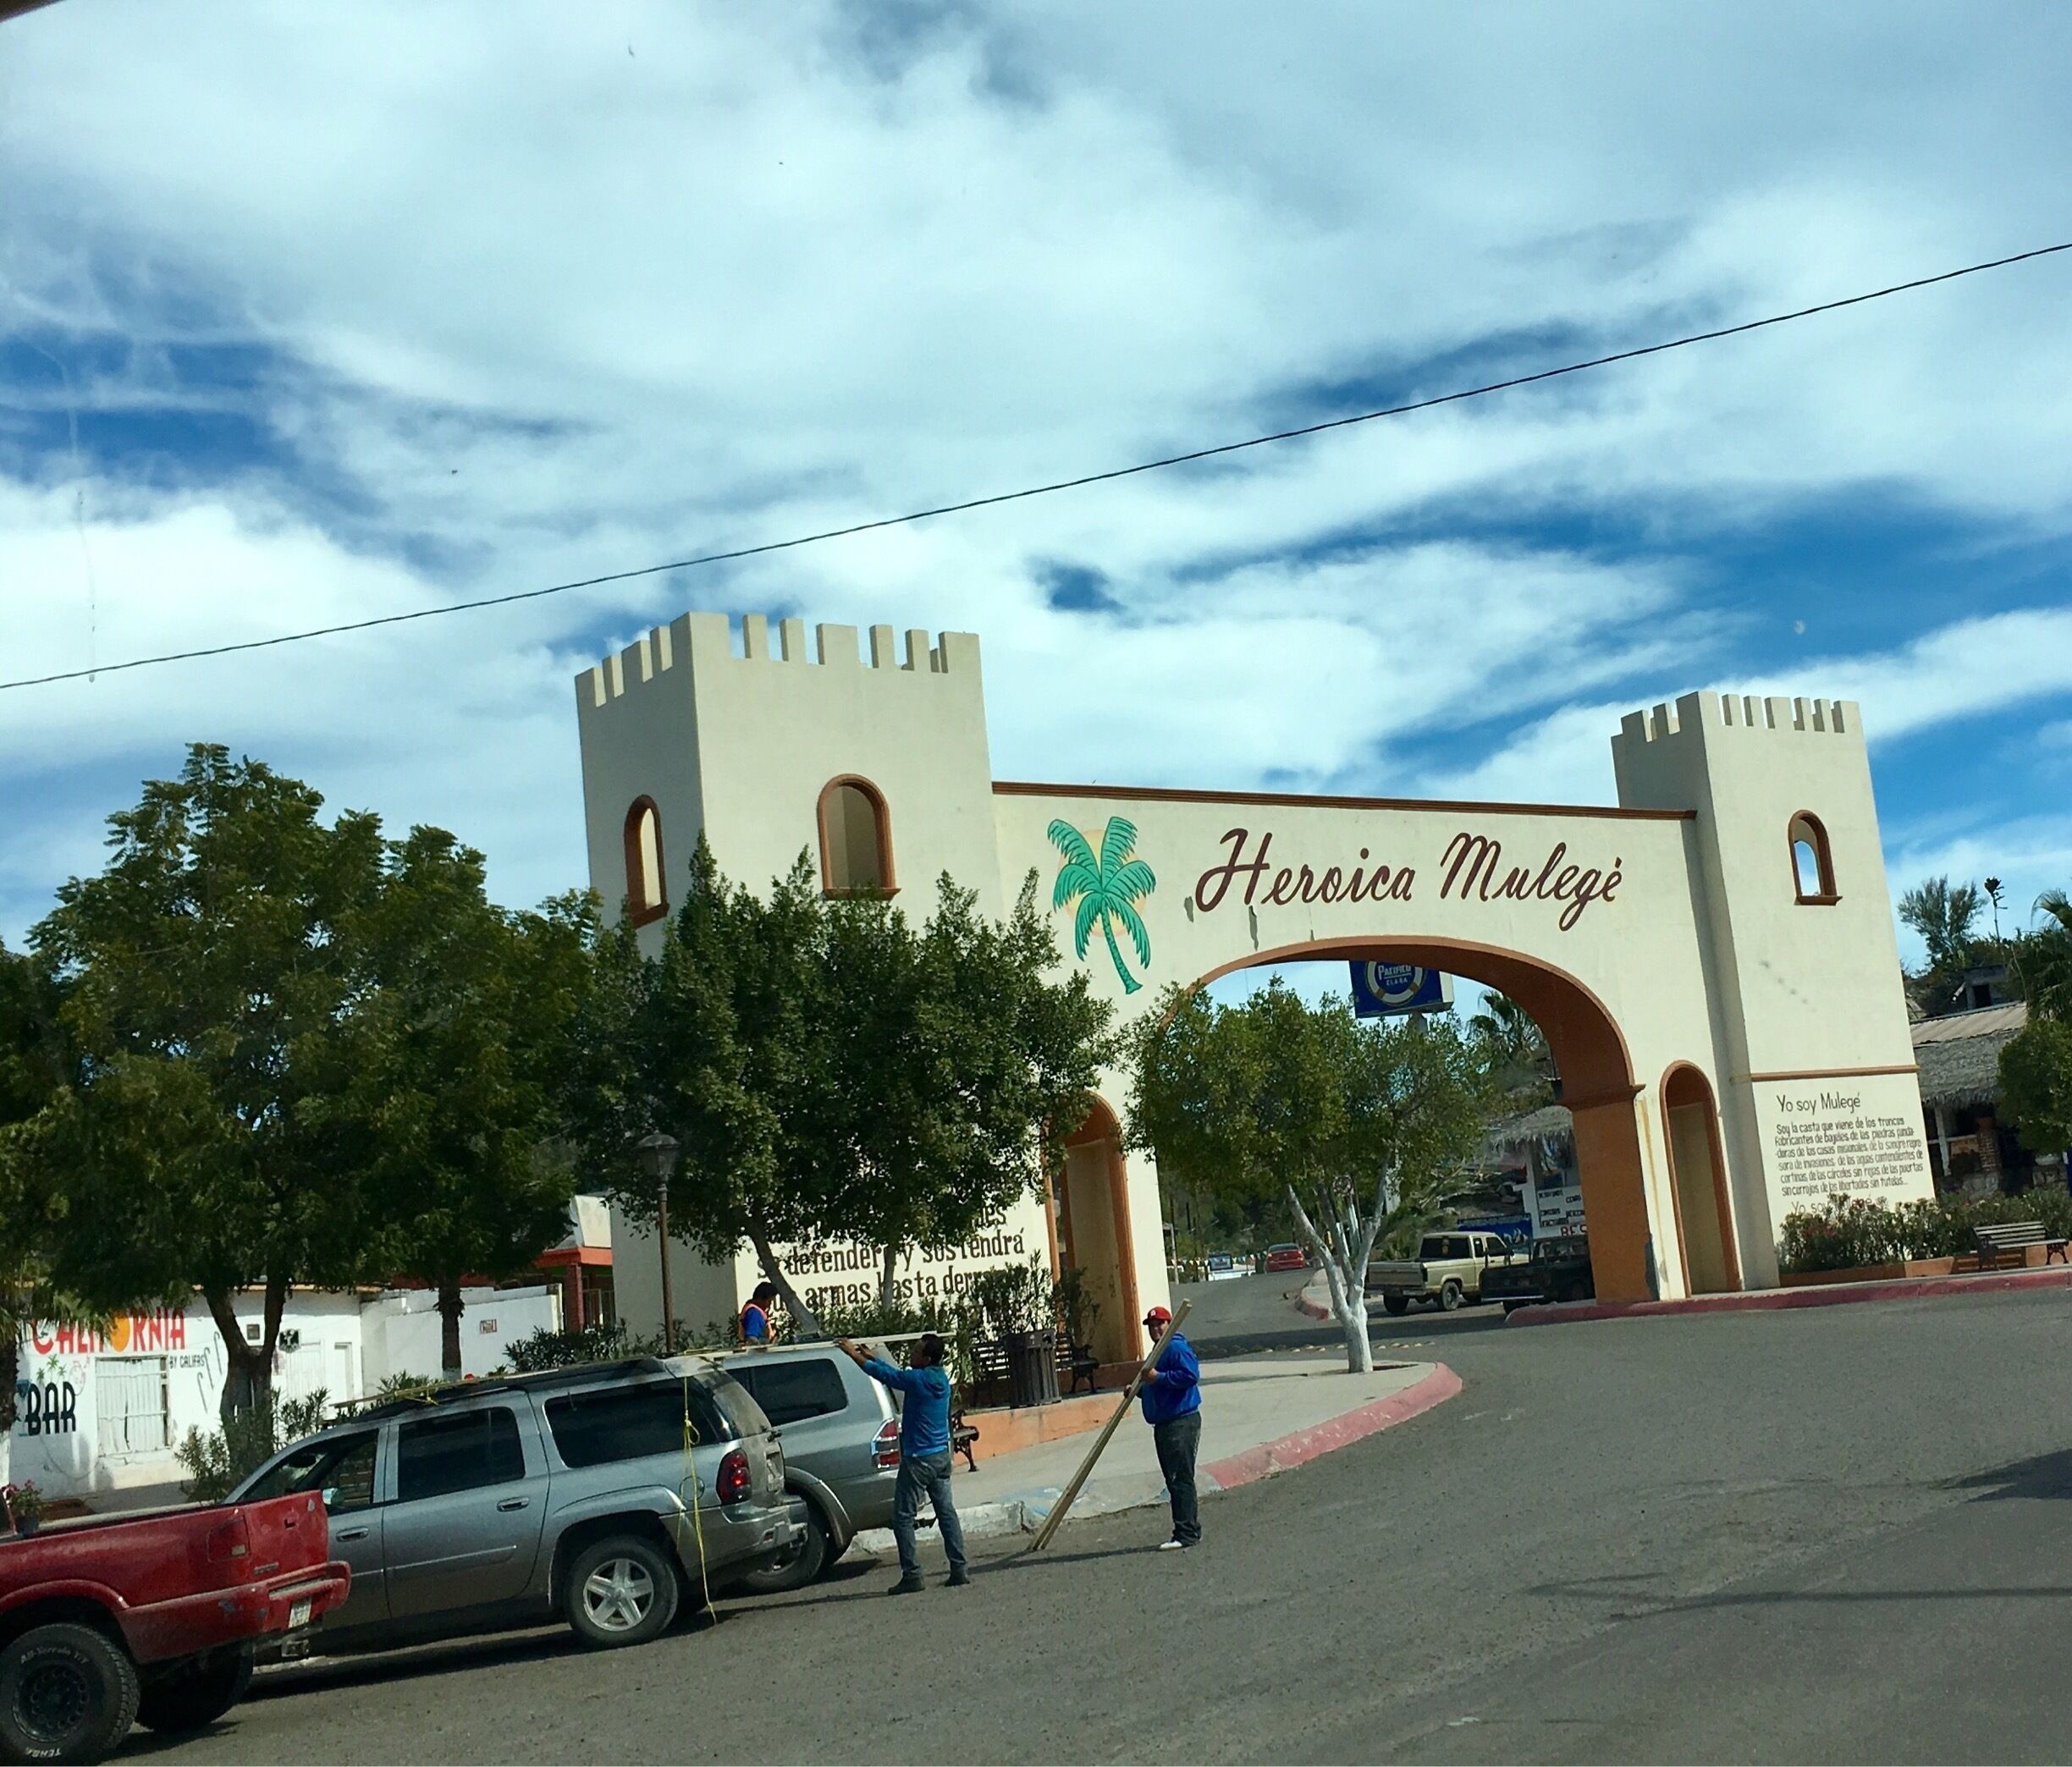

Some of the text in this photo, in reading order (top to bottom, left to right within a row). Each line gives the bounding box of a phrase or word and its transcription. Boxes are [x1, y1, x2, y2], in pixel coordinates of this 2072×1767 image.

[1195, 828, 1416, 911] Heroica
[1776, 1091, 1861, 1116] Yo soy Mulegé
[1776, 1123, 1790, 1137] Soy
[1791, 1121, 1798, 1133] la
[1799, 1121, 1820, 1133] casta
[1821, 1122, 1833, 1135] que
[1835, 1120, 1854, 1131] viene
[1855, 1116, 1864, 1129] de
[1865, 1116, 1876, 1128] los
[1815, 1134, 1823, 1144] de
[1850, 1131, 1859, 1141] de
[1796, 1147, 1805, 1157] de
[1816, 1145, 1836, 1156] casas
[1869, 1140, 1877, 1151] de
[1794, 1159, 1802, 1170] de
[1838, 1155, 1846, 1166] de
[1916, 1149, 1923, 1159] de
[1809, 1170, 1816, 1181] de
[1853, 1168, 1862, 1177] sin
[1881, 1164, 1889, 1175] de
[1782, 1186, 1792, 1197] sin
[1821, 1181, 1828, 1193] de
[1870, 1179, 1879, 1188] sin
[1792, 1201, 1806, 1215] Yo
[787, 1241, 897, 1276] defender
[804, 1281, 872, 1310] armas
[169, 1356, 178, 1369] BY
[25, 1381, 76, 1436] BAR
